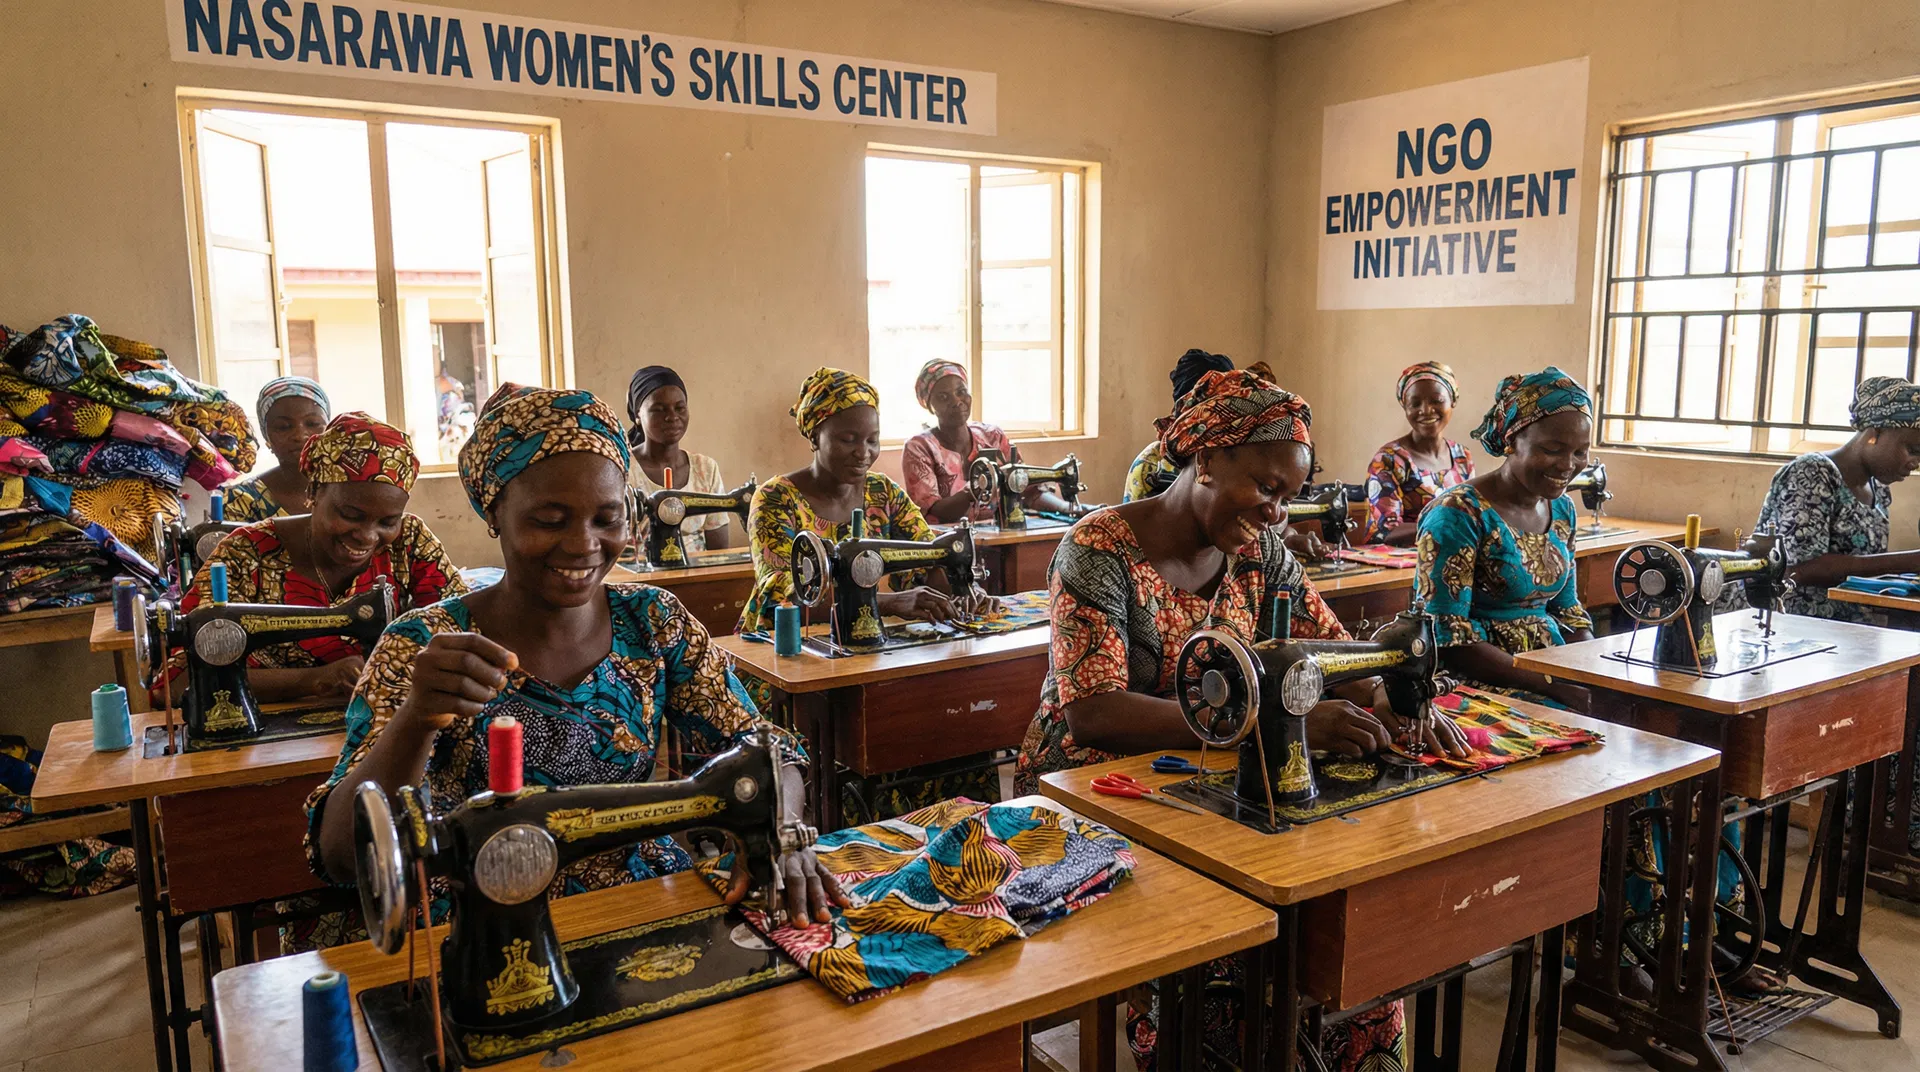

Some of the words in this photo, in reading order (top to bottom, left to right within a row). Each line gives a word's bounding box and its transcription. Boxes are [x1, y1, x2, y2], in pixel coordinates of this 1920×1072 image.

[184, 0, 473, 79] NASARAWA
[483, 22, 675, 98] WOMEN'S
[689, 47, 821, 111] SKILLS
[833, 63, 967, 125] CENTER
[1396, 117, 1492, 179] NGO
[1326, 168, 1576, 235] EMPOWERMENT
[1353, 228, 1517, 279] INITIATIVE
